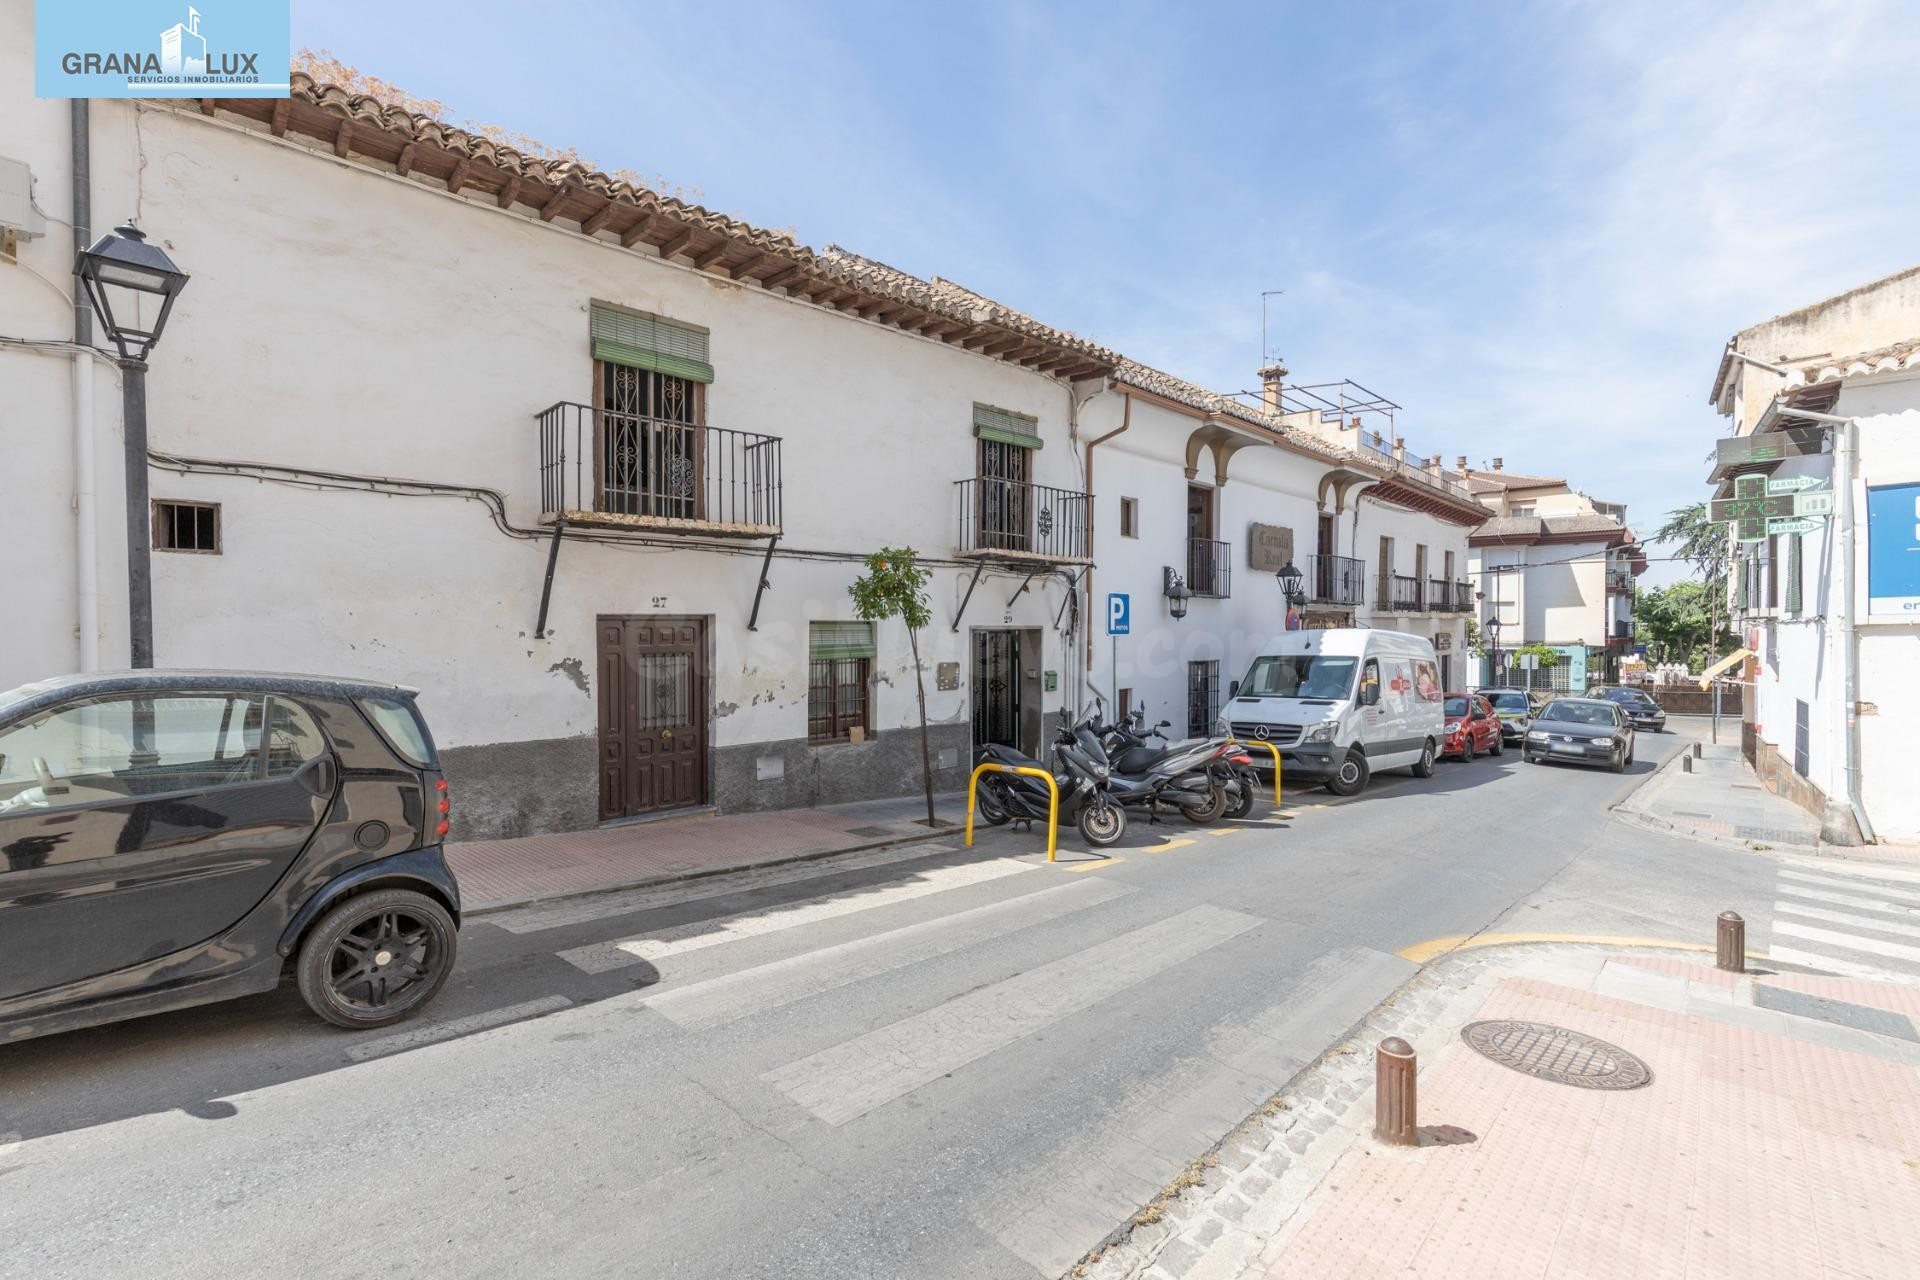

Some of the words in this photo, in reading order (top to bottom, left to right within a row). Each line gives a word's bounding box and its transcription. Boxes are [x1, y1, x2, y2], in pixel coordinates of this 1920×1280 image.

[1770, 479, 1815, 489] FARMACIA
[1770, 523, 1815, 532] FARMACIA
[651, 596, 667, 608] 27
[1110, 597, 1125, 631] P
